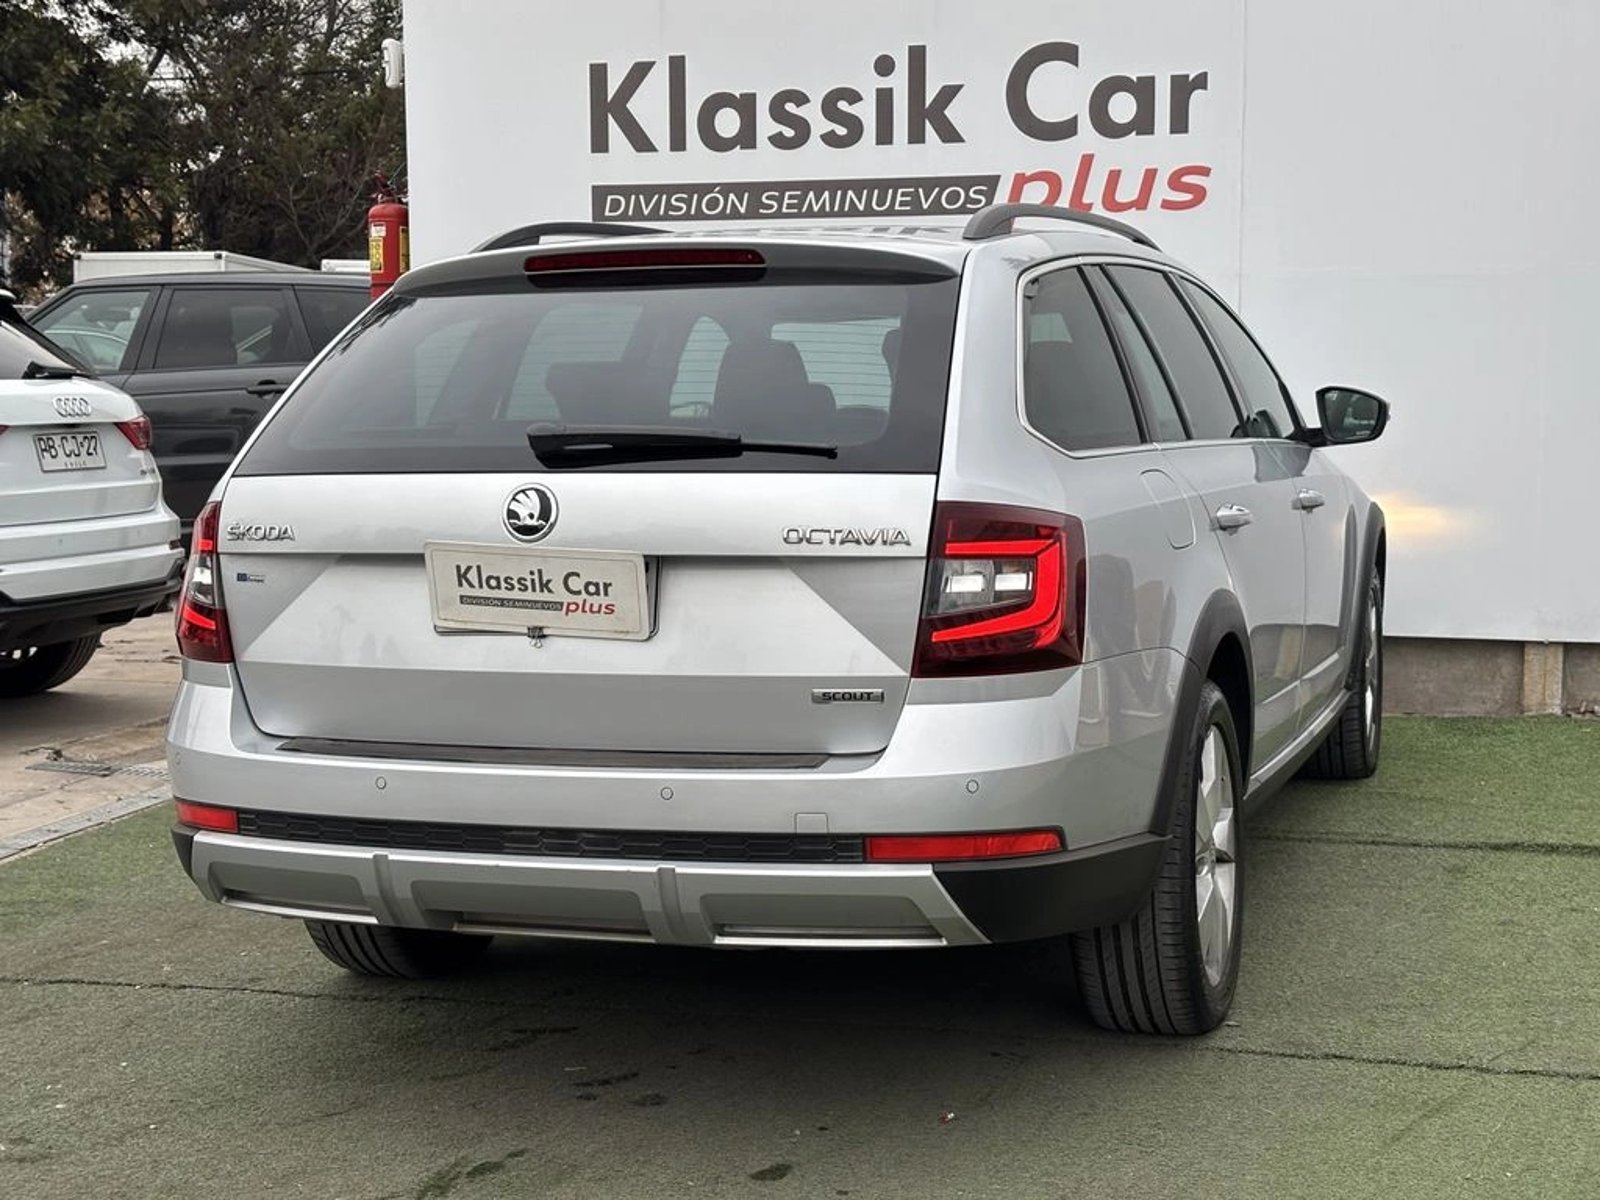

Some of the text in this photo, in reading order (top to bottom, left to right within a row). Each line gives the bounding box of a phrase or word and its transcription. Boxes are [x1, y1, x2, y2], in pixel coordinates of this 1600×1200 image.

[589, 42, 1208, 154] Klassik Car
[604, 181, 988, 216] DIVISIÓN SEMINUEVOS
[1007, 153, 1212, 230] plus
[783, 527, 912, 546] OCTAVIA
[455, 564, 613, 597] Klassik Car
[565, 599, 616, 616] plus
[821, 691, 875, 701] SCOUT
